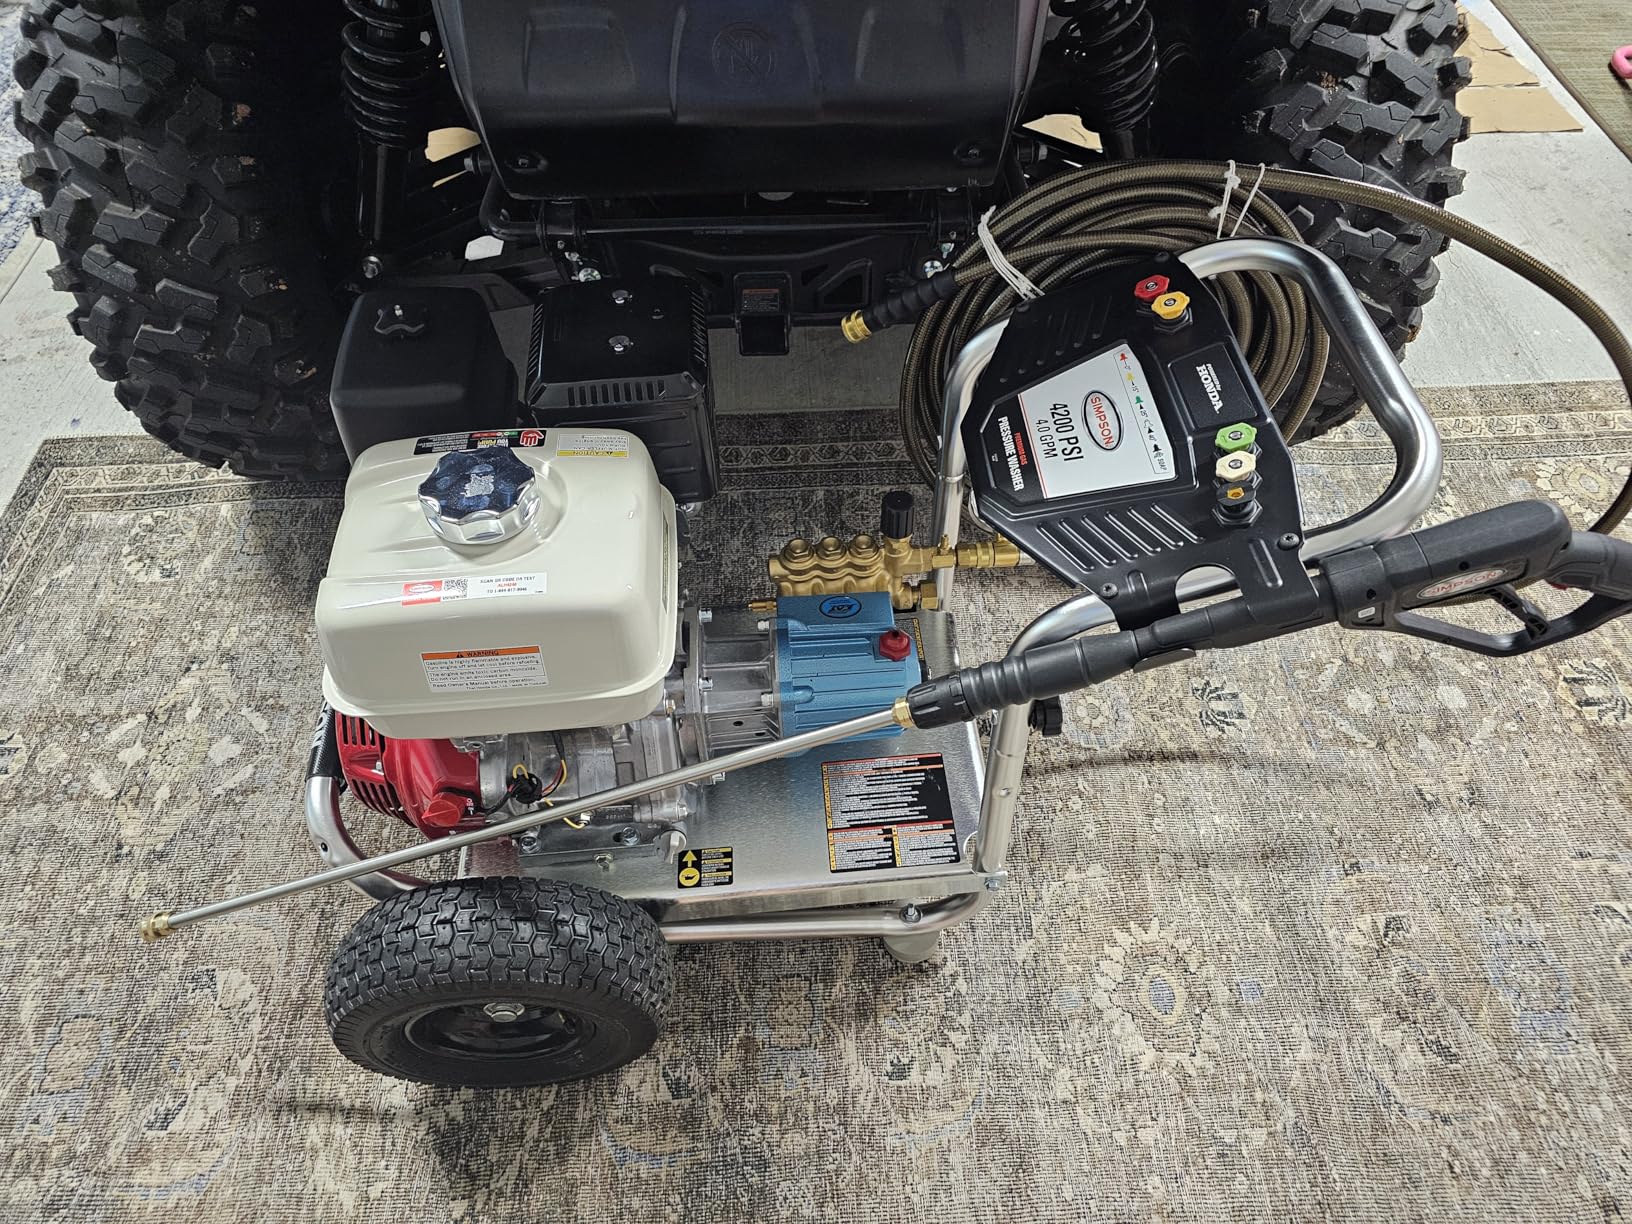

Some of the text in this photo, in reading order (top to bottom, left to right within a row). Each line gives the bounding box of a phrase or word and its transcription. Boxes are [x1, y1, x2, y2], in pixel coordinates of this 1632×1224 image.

[1195, 364, 1223, 412] HONDA
[1035, 419, 1058, 459] 4.0 GPM
[1049, 403, 1084, 461] 4200 PSI
[1090, 396, 1115, 446] SIMPSON
[997, 415, 1025, 491] PRESSURE WASHER
[1426, 570, 1498, 596] SIMPSON
[466, 649, 499, 658] WARNING
